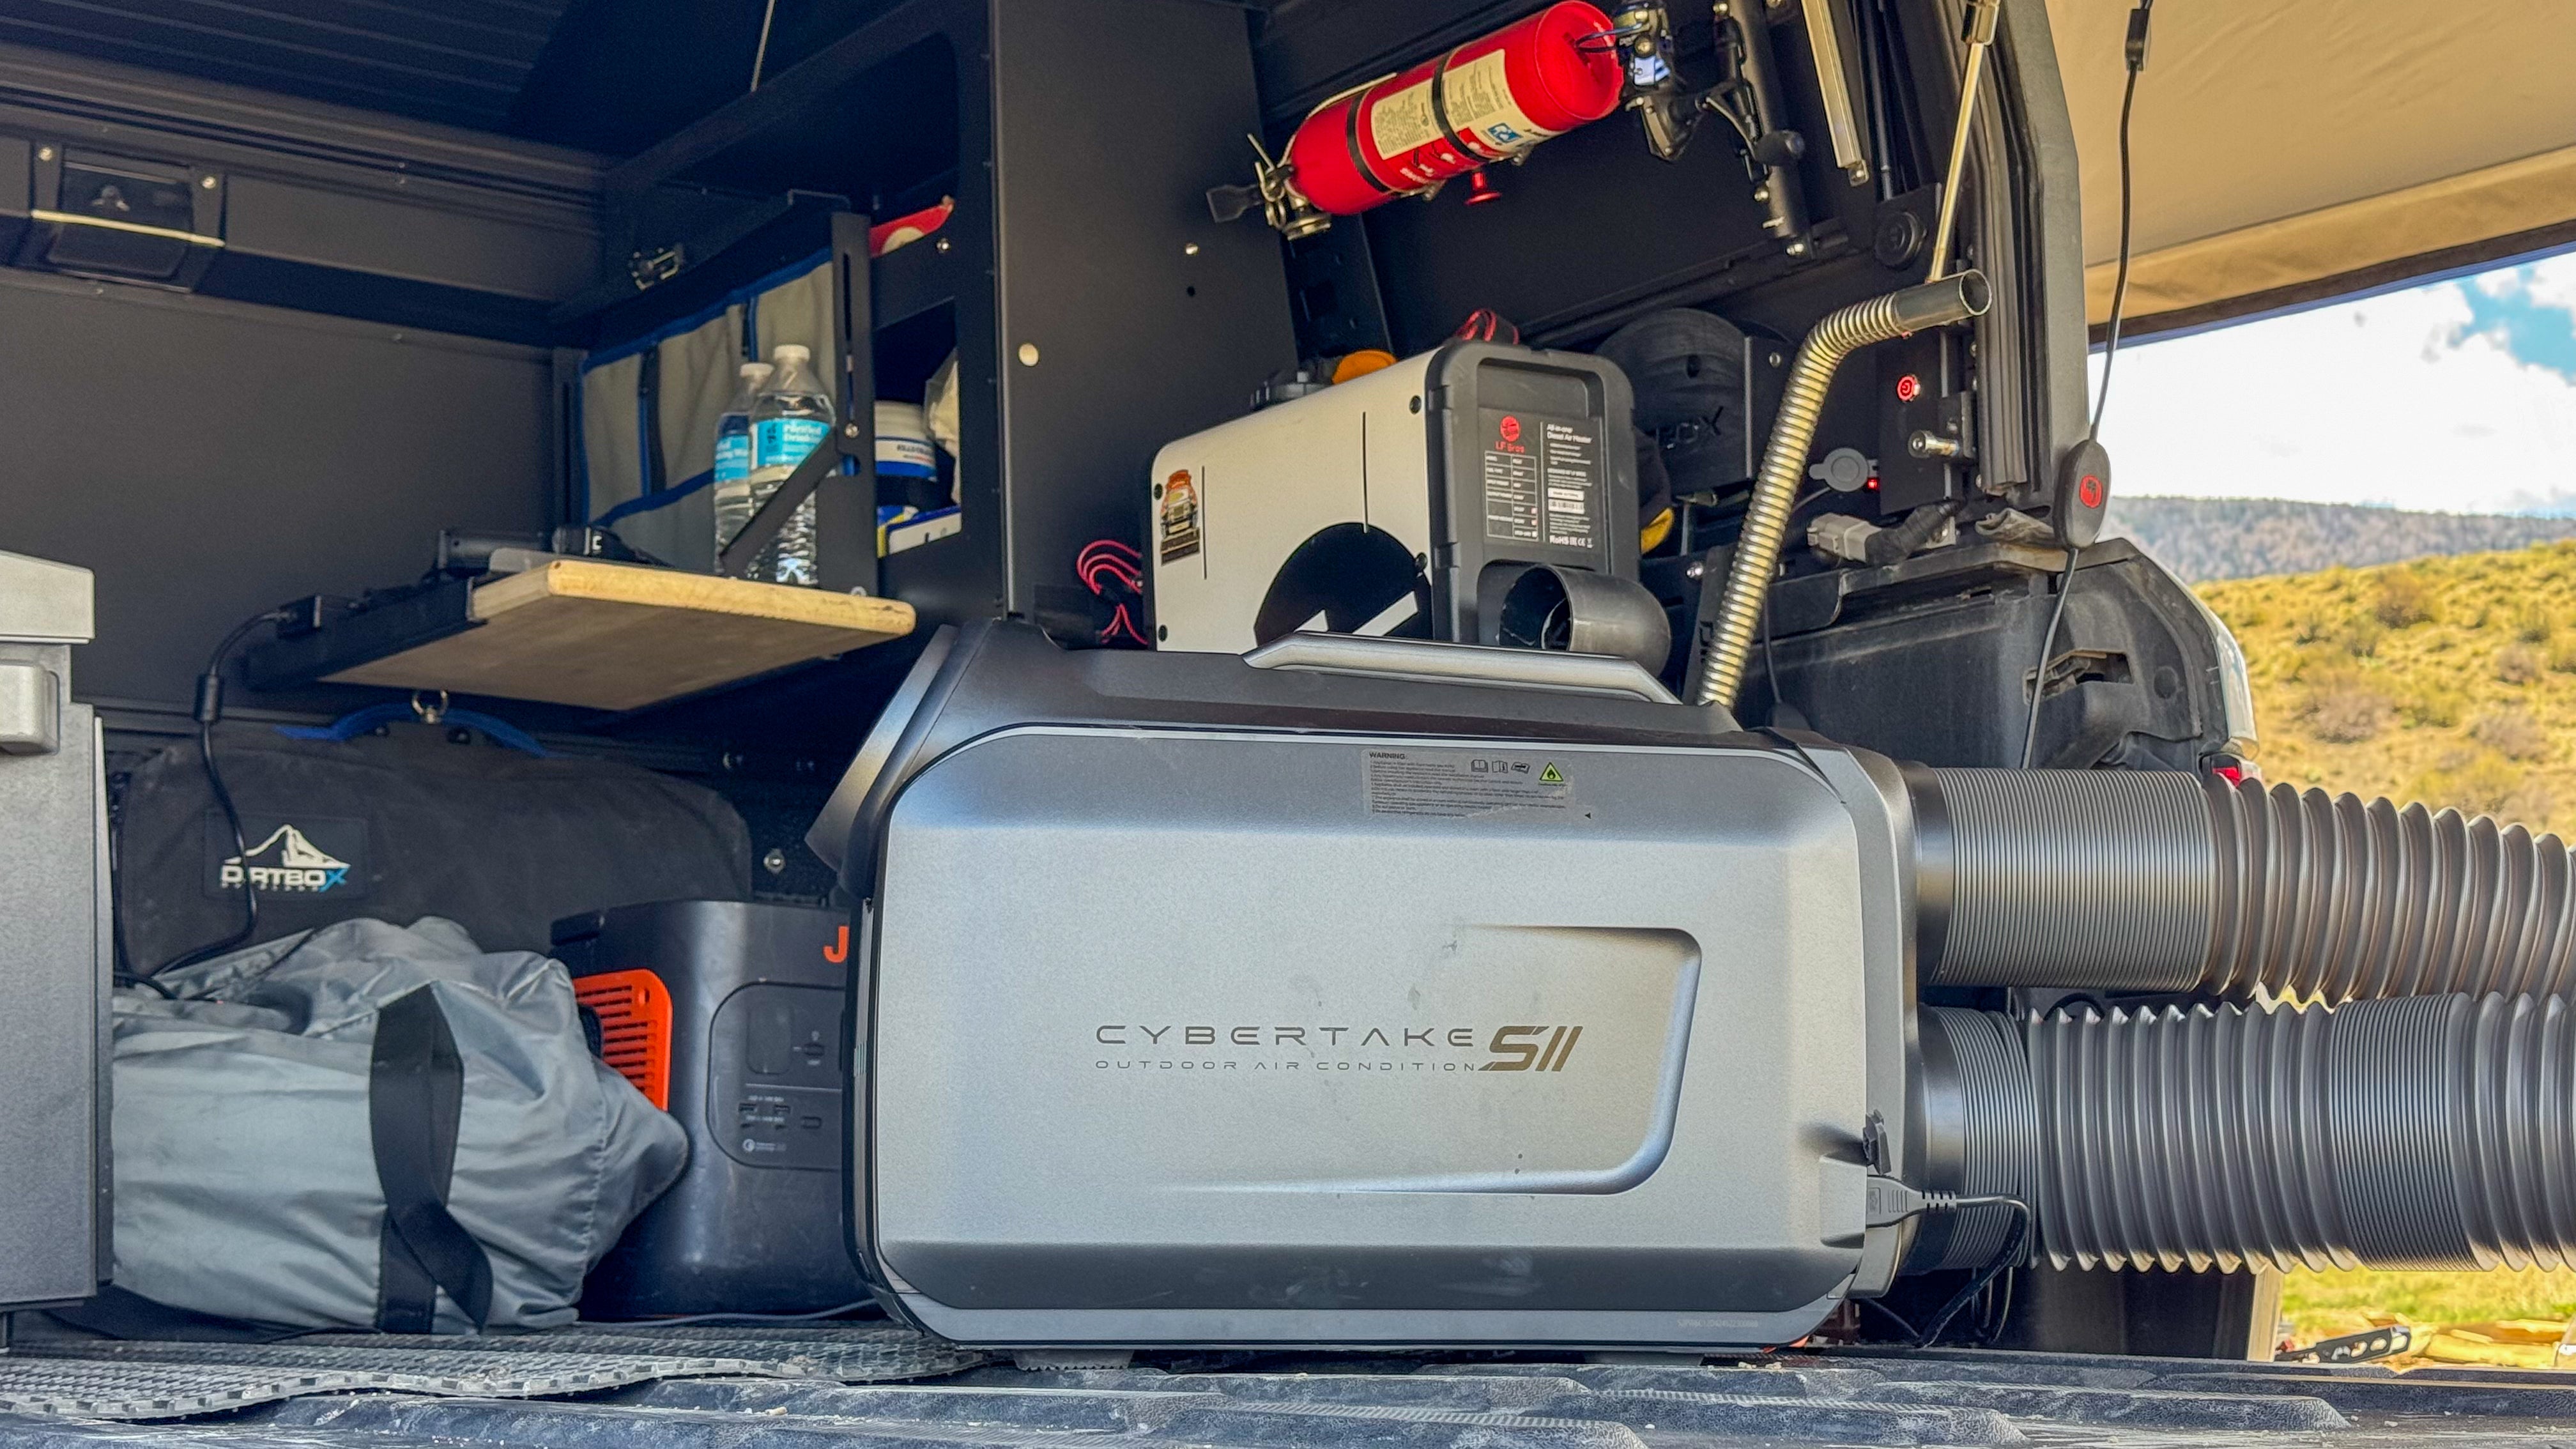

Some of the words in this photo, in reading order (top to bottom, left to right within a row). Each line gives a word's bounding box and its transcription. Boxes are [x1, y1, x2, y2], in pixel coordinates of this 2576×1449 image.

[220, 864, 349, 893] DRTBOX
[1096, 1025, 1473, 1047] CYBERTAKE
[1095, 1060, 1237, 1070] OUTDOOR
[1254, 1061, 1300, 1070] AIR
[1316, 1061, 1475, 1071] CONDITION
